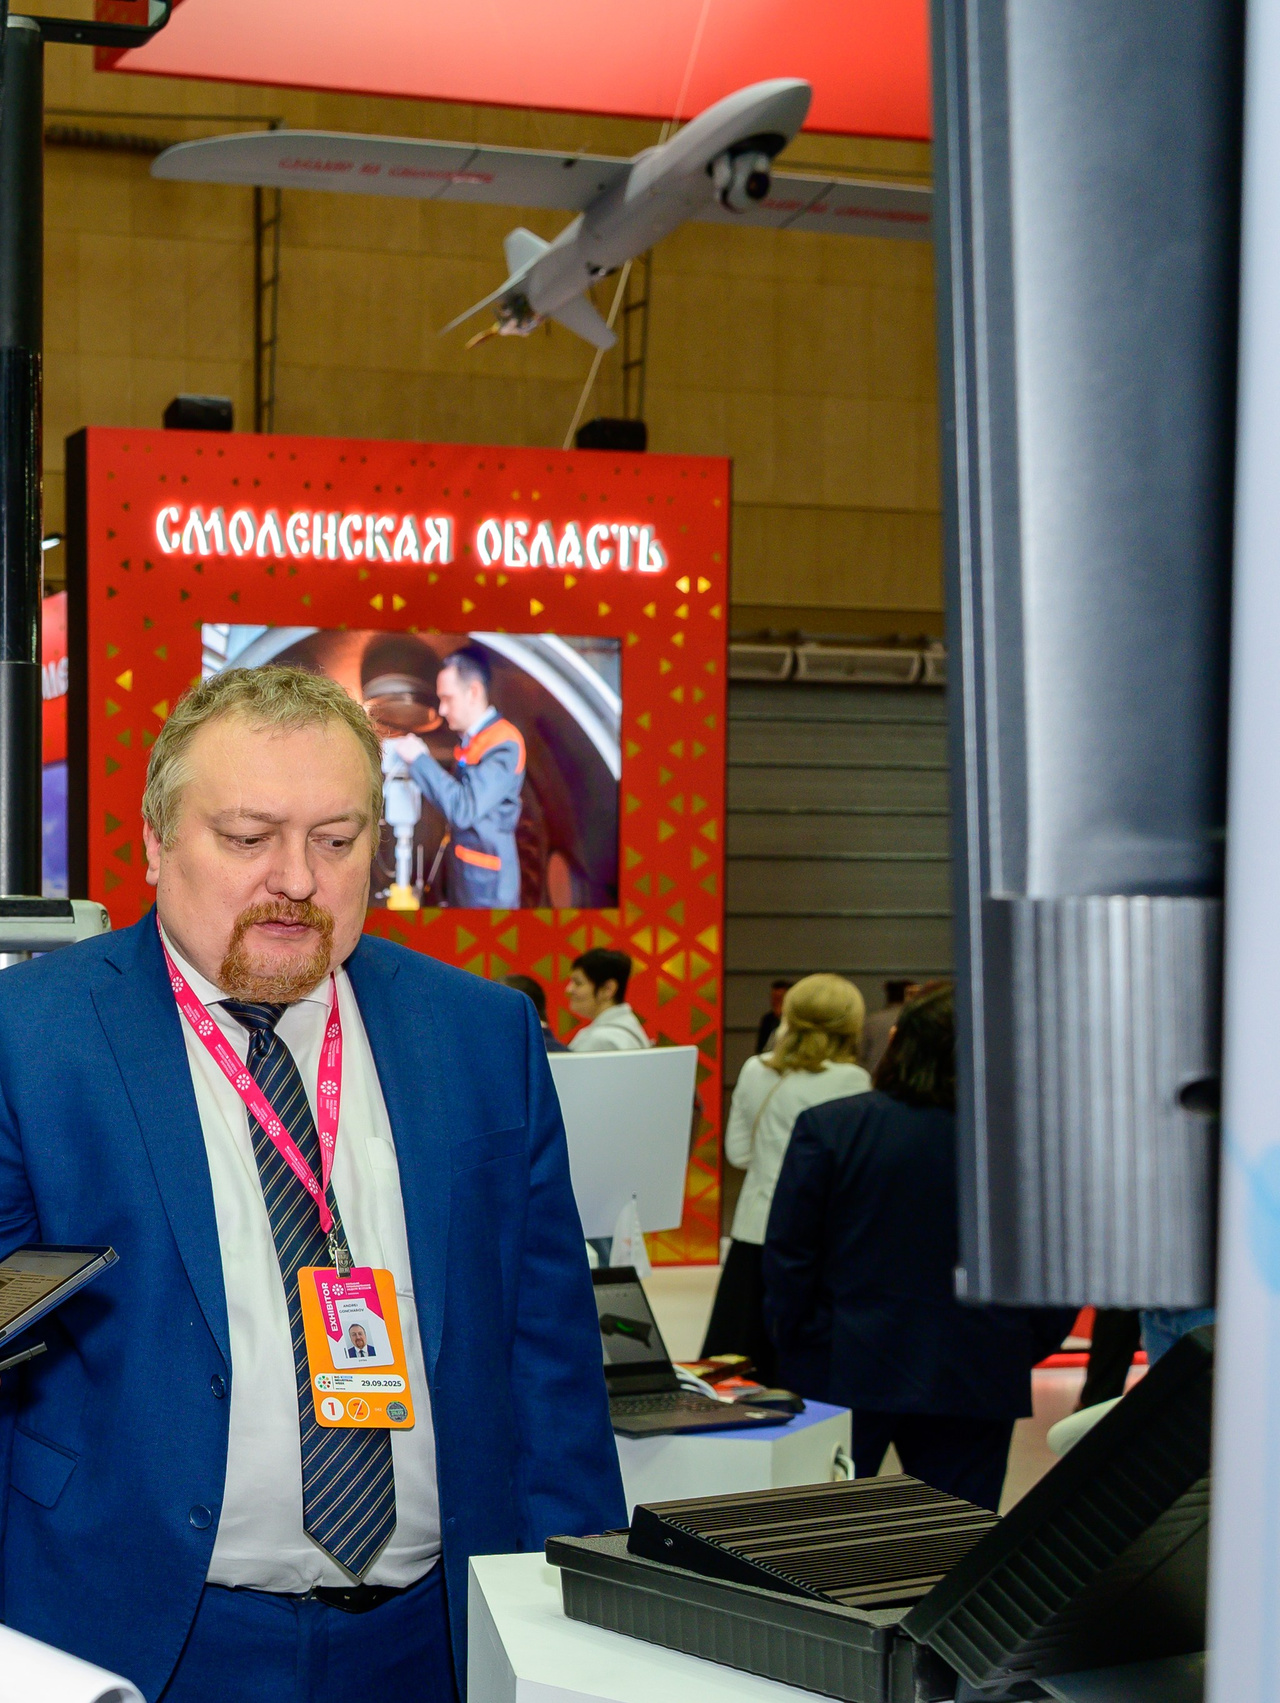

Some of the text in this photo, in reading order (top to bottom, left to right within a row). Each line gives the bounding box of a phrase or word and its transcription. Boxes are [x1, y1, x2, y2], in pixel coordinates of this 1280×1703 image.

[155, 506, 668, 572] СМОЛЕНСКАЯ ОБЛАСТЬ
[321, 1282, 338, 1332] EXHIBITOR
[328, 1402, 335, 1416] 1
